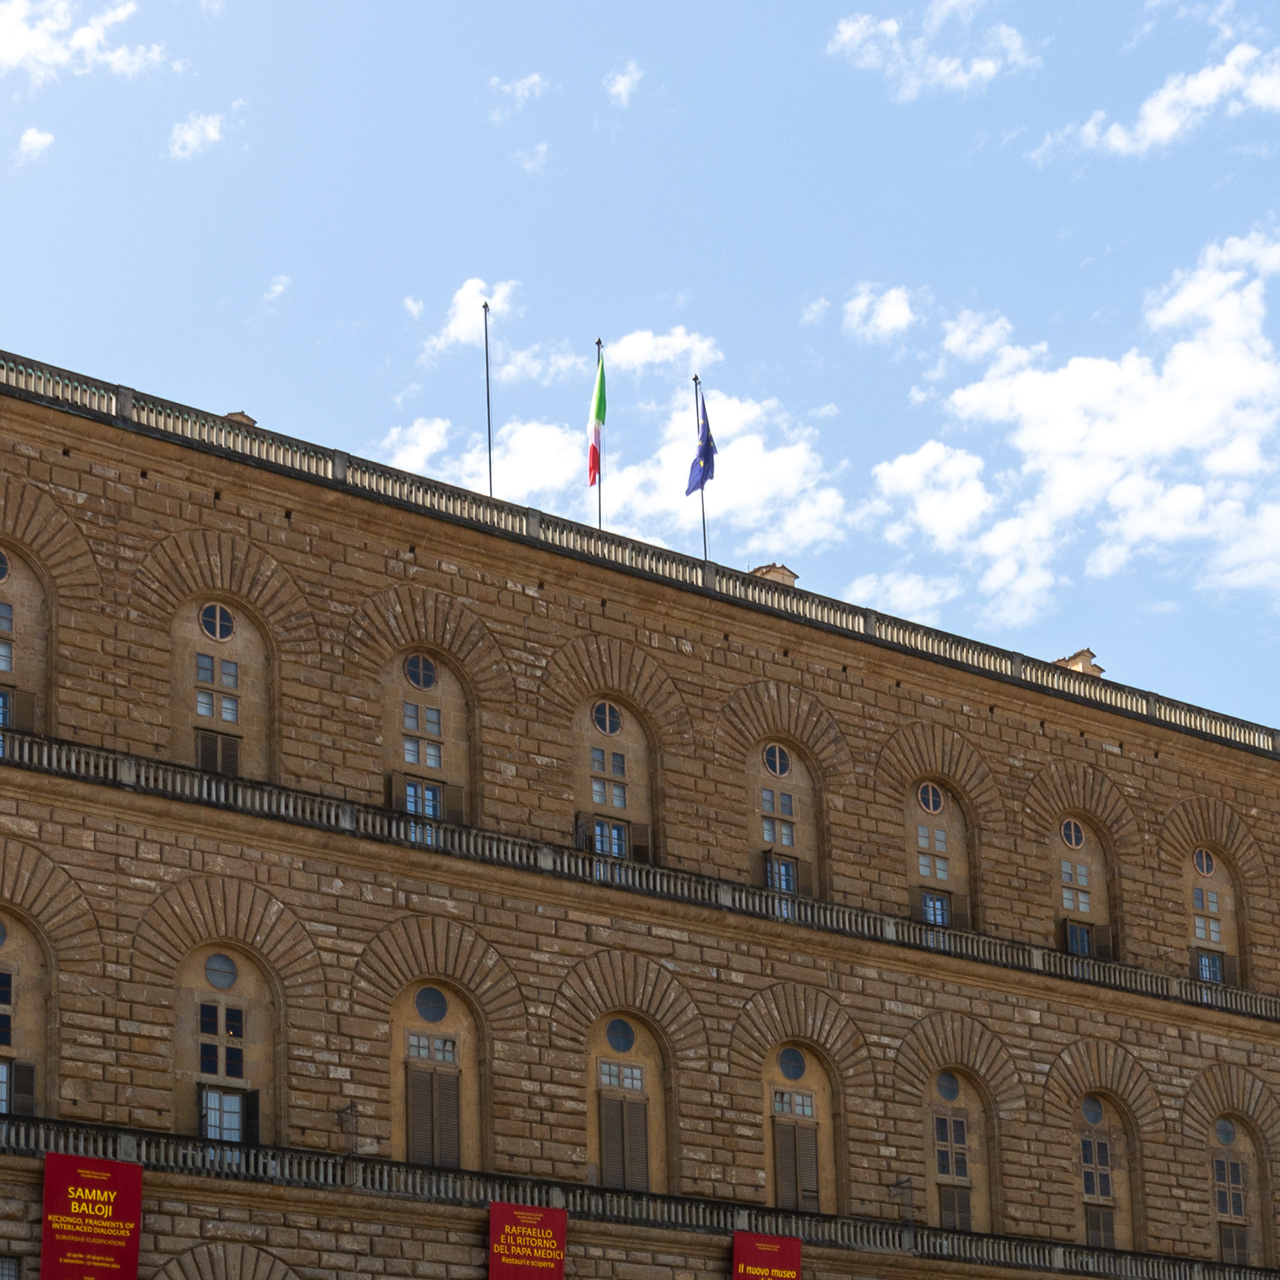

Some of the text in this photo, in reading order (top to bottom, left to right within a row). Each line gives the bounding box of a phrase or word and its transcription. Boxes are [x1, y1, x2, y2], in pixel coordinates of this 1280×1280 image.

[68, 1186, 117, 1203] SAMMY
[71, 1201, 113, 1219] BALOJI
[52, 1222, 130, 1237] INTERLACED DIALOGUES
[85, 1218, 124, 1229] FRAGMENTS
[125, 1222, 135, 1230] OF
[504, 1225, 553, 1239] RAFFAELLO
[501, 1235, 557, 1249] E IL RITORNO
[493, 1244, 564, 1260] DEL PAPA MEDICI
[502, 1256, 526, 1266] Restauri
[531, 1260, 555, 1269] scoperte
[738, 1263, 797, 1279] Il nuovo museo
